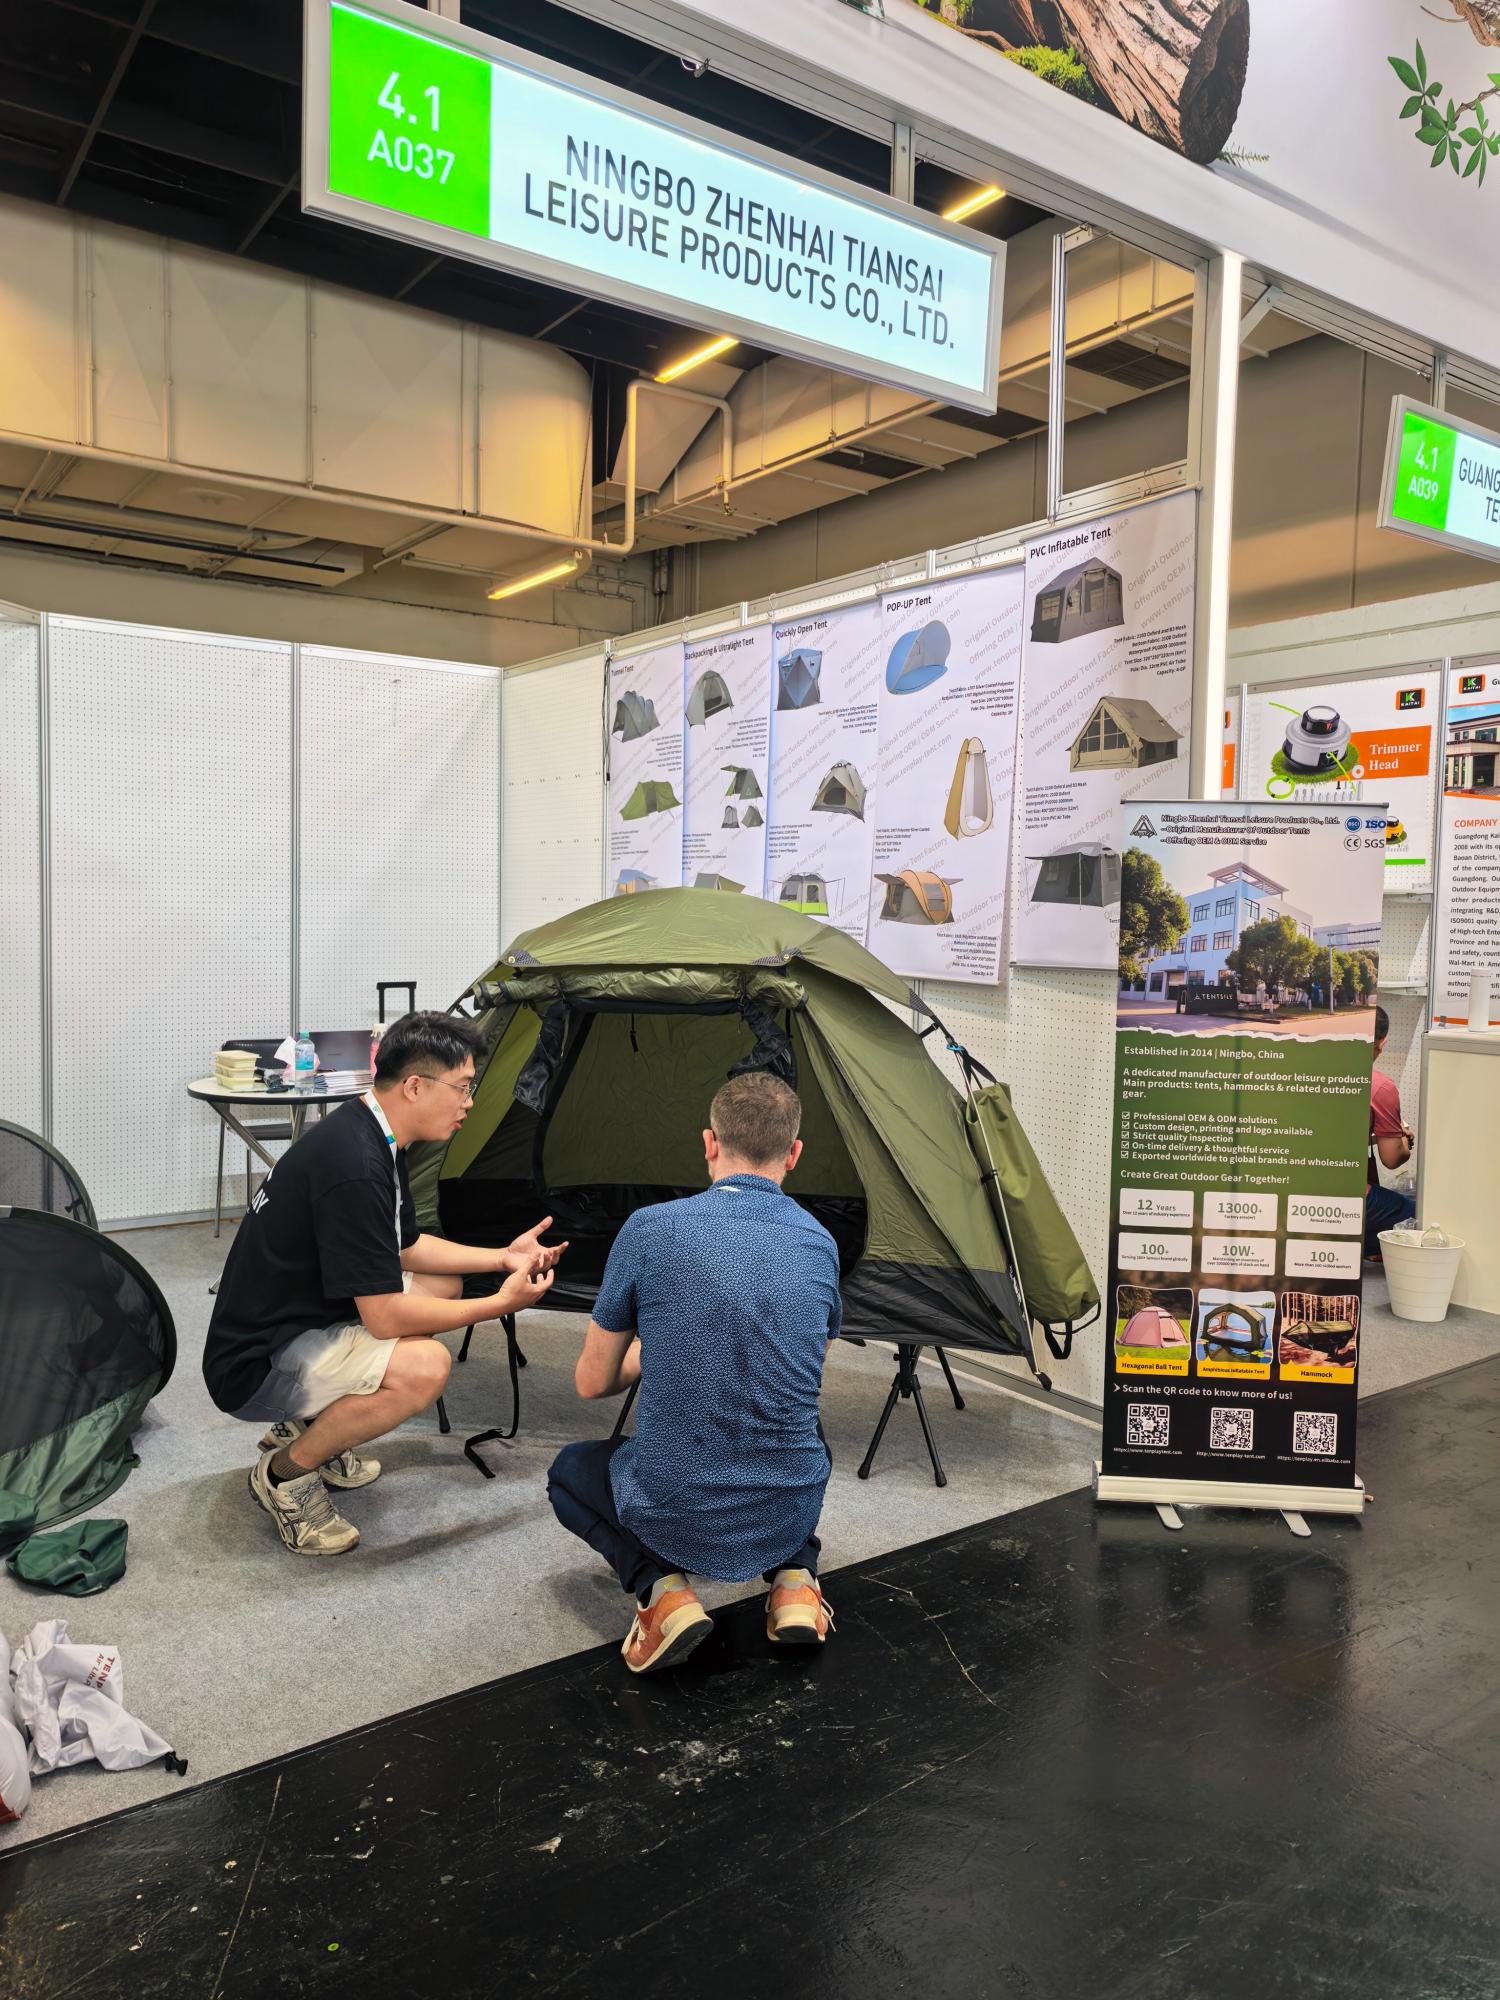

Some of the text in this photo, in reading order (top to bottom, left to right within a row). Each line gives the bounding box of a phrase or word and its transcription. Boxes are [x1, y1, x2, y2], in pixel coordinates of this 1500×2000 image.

[377, 71, 440, 132] 4.1
[367, 128, 455, 185] A037
[566, 134, 943, 303] NINGBO ZHENHAI TIANSAI
[525, 172, 954, 349] LEISURE PRODUCTS CO., LTD.
[1414, 442, 1439, 473] 4.1
[1407, 475, 1439, 502] A039
[1486, 496, 1500, 523] TE
[1030, 527, 1111, 559] PVC Inflatable Tent
[886, 595, 932, 613] POP-UP Tent
[775, 620, 828, 641] Quickly Open Tent
[684, 647, 713, 660] Backpacking
[742, 637, 754, 647] Tent
[1369, 743, 1422, 755] Trimmer
[1369, 758, 1399, 771] Head
[1160, 814, 1188, 824] Ningbo
[1188, 814, 1219, 823] Zhenhai
[1219, 814, 1246, 823] Tiansai
[1246, 815, 1274, 824] Leisure
[1274, 816, 1309, 824] Products
[1324, 816, 1340, 825] Ltd.
[1365, 820, 1387, 829] ISO
[1454, 819, 1498, 828] COMPANY
[1196, 825, 1246, 834] Manufacturer
[1257, 826, 1288, 835] Outdoor
[1287, 826, 1310, 835] Tents
[1196, 837, 1214, 845] OEM
[1221, 837, 1240, 845] ODM
[1240, 837, 1267, 846] Service
[1364, 839, 1385, 849] SGS
[1476, 918, 1498, 926] quality
[1462, 949, 1482, 957] safety,
[1447, 990, 1468, 998] Europe
[1124, 1046, 1285, 1060] Established in 2014 Ningbo, China
[1123, 1067, 1372, 1085] A dedicated manufacturer of outdoor leisure products.
[1123, 1078, 1362, 1095] Main products: tents, hammocks & related outdoor
[1122, 1090, 1147, 1099] gear.
[1133, 1112, 1278, 1125] Professional OEM & ODM solutions
[1133, 1122, 1313, 1136] Custom design, printing and logo available
[1132, 1131, 1234, 1143] Strict quality inspection
[1132, 1141, 1290, 1155] On-time delivery & thoughtful service
[1132, 1151, 1360, 1168] Exported worldwide to global brands and wholesalers
[1120, 1169, 1290, 1185] Create Great Outdoor Gear Together!
[1137, 1199, 1176, 1212] 12 Years
[1217, 1202, 1262, 1214] 13000+
[1140, 1243, 1169, 1255] 100+
[1222, 1245, 1255, 1257] 10W+
[1310, 1251, 1339, 1263] 100+
[1122, 1362, 1154, 1371] Hexagonal
[1168, 1363, 1183, 1371] Tent
[1300, 1370, 1333, 1378] Hammock
[1122, 1384, 1293, 1400] Scan the QR code to know more of us!
